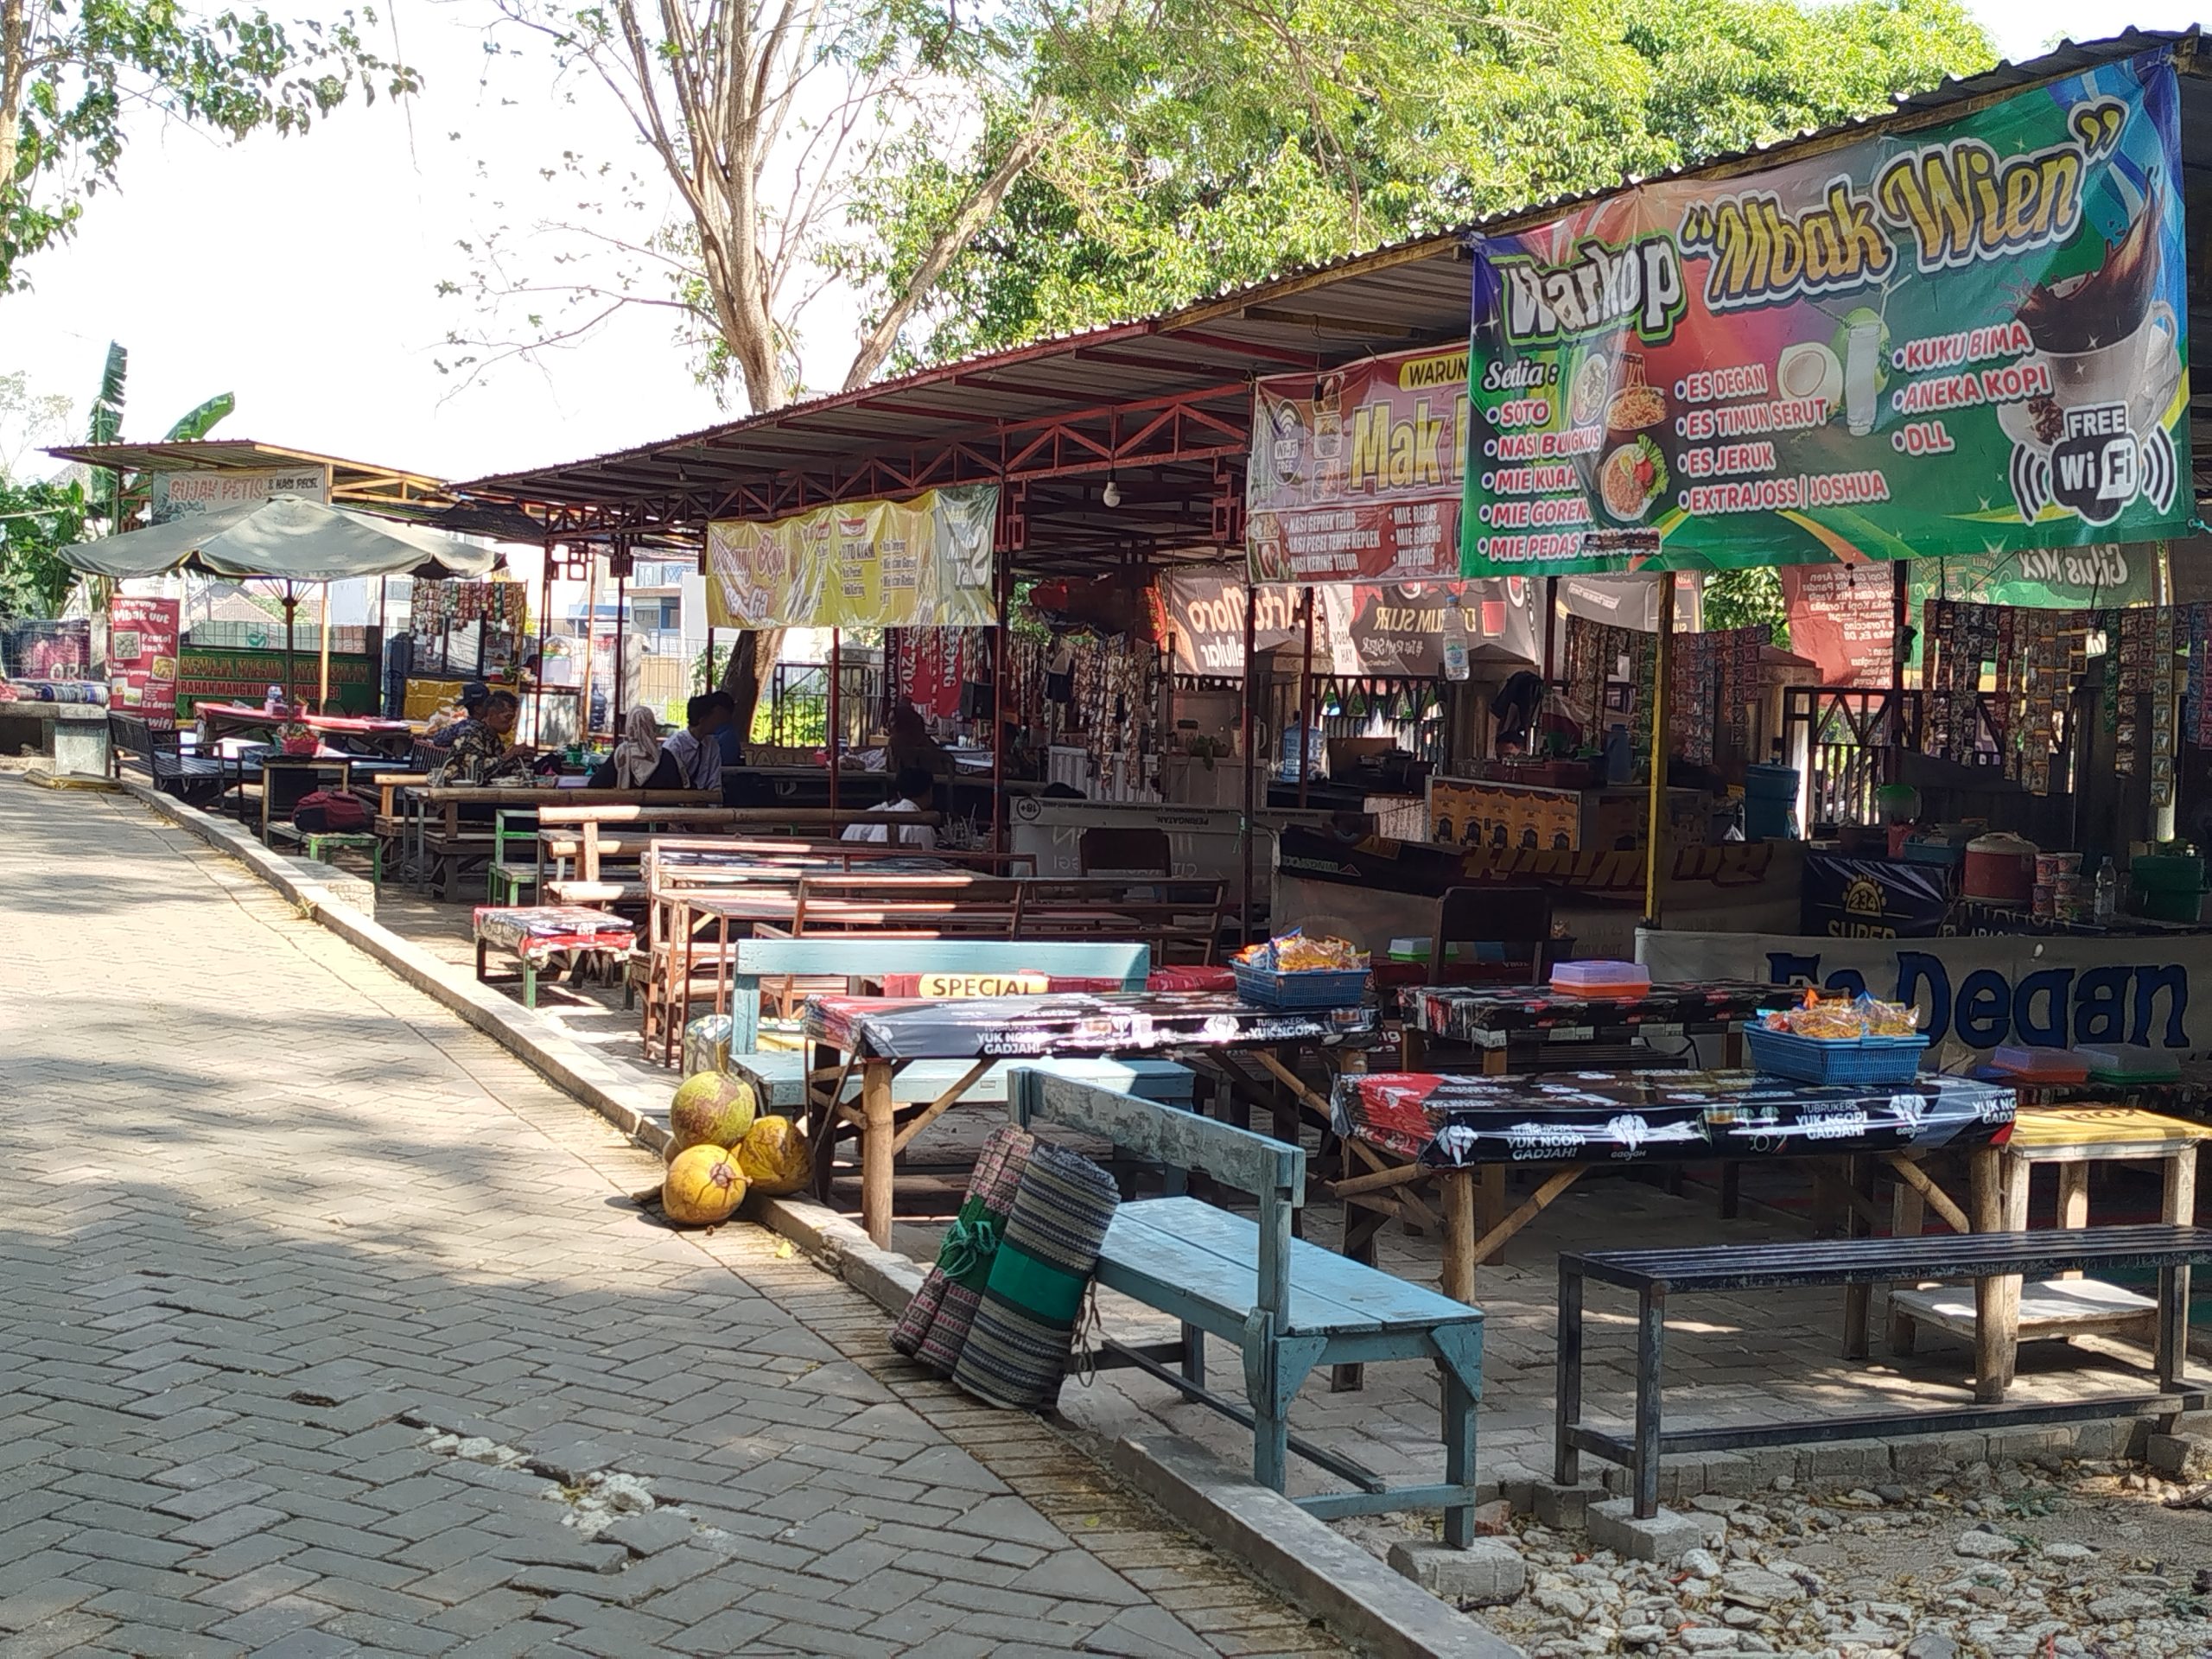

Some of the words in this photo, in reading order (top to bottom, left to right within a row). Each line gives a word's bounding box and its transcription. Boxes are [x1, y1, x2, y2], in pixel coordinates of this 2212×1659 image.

[1502, 237, 1684, 335] Warkop
[1905, 330, 1968, 372] KUKU
[1967, 321, 2034, 359] BIMA
[1408, 357, 1469, 387] WARUN
[1482, 359, 1544, 390] Sedia
[1688, 373, 1713, 402] ES
[1713, 365, 1769, 400] DEGAN
[1901, 372, 1985, 414] ANEKA
[1982, 361, 2054, 400] KOPI
[1501, 400, 1550, 426] SOTO
[1688, 410, 1715, 439] ES
[1715, 402, 1771, 437] TIMUN
[1771, 397, 1827, 430] SERUT
[2068, 408, 2126, 438] FREE
[1350, 401, 1446, 493] Mak
[1497, 434, 1539, 460] NASI
[1904, 421, 1955, 455] DLL
[1276, 460, 1294, 474] FREE
[1688, 448, 1714, 476] ES
[1714, 442, 1777, 474] JERUK
[169, 479, 218, 501] RUJAK
[220, 478, 264, 500] PETIS
[1496, 468, 1535, 493] MIE
[1690, 480, 1799, 514] EXTRAJOSS
[1809, 470, 1890, 505] JOSHUA
[1289, 516, 1306, 533] NASI
[1307, 513, 1333, 531] GEPREK
[1394, 507, 1412, 525] MIE
[1413, 503, 1438, 524] REBUS
[1492, 501, 1532, 527] MIE
[1532, 499, 1592, 525] GOREN
[1288, 536, 1306, 554] NASI
[1328, 531, 1351, 550] TEMPE
[1395, 528, 1412, 547] MIE
[1412, 524, 1441, 544] GORENG
[1489, 535, 1528, 561] MIE
[1528, 532, 1579, 557] PEDAS
[1291, 556, 1306, 573] NASI
[1306, 555, 1332, 571] KERING
[1397, 550, 1414, 568] MIE
[1414, 550, 1435, 566] PEDAS
[113, 608, 147, 623] Mbak
[121, 599, 157, 611] Warung
[141, 632, 172, 643] Pentol
[1020, 803, 1038, 815] 18+
[1154, 815, 1209, 826] PERINGATAN:
[1851, 893, 1878, 911] 234
[1795, 1114, 1822, 1127] YUK
[1823, 1110, 1868, 1126] NGOPI
[1972, 1099, 1999, 1114] YUK
[1507, 1136, 1537, 1149] YUK
